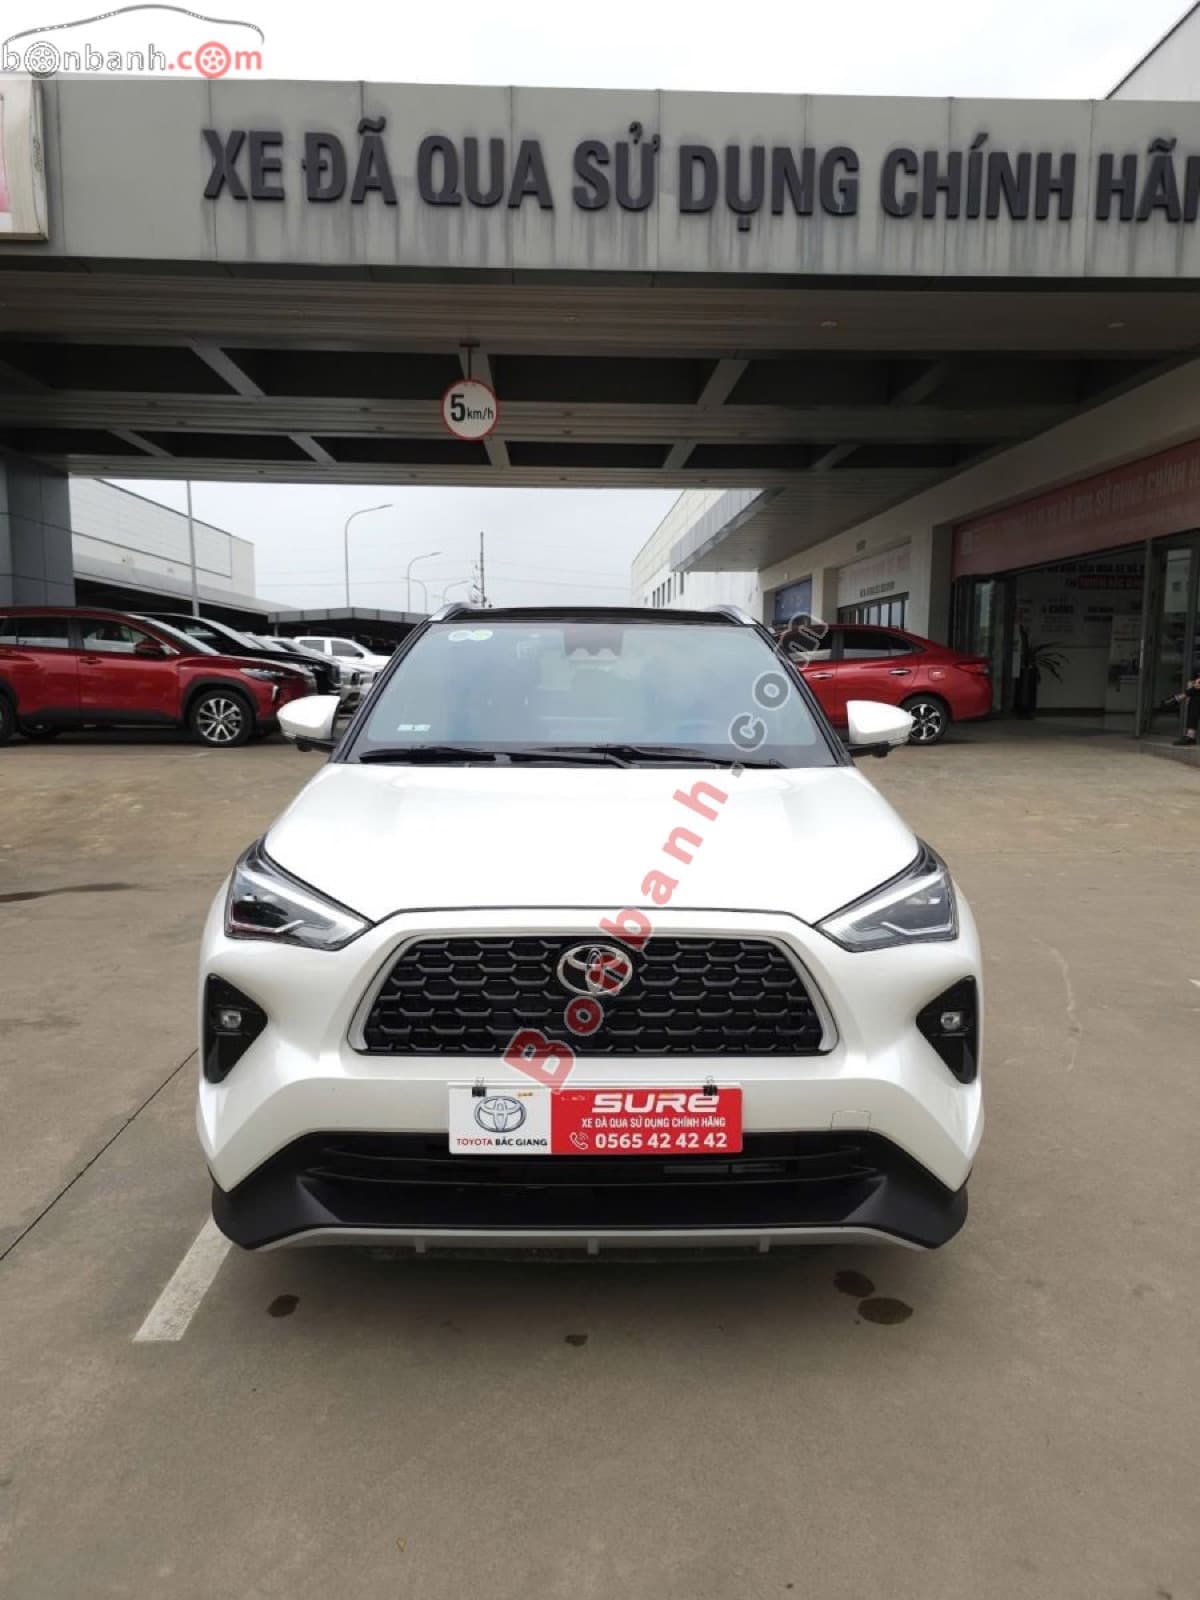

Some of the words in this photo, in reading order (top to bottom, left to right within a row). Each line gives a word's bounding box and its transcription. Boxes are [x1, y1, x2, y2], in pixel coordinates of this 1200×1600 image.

[203, 129, 285, 201] XE
[302, 116, 398, 206] ĐÃ
[417, 134, 554, 210] QUA
[572, 121, 661, 212] SỬ
[678, 145, 860, 231] DỤNG
[880, 132, 1077, 221] CHÍNH
[582, 1118, 593, 1128] XE
[609, 1118, 628, 1128] QUA
[456, 1138, 493, 1146] TOYOTA
[515, 1138, 548, 1146] GIANG
[595, 1133, 643, 1149] 0565
[647, 1132, 672, 1149] 42
[675, 1132, 700, 1148] 42
[703, 1132, 728, 1148] 42
